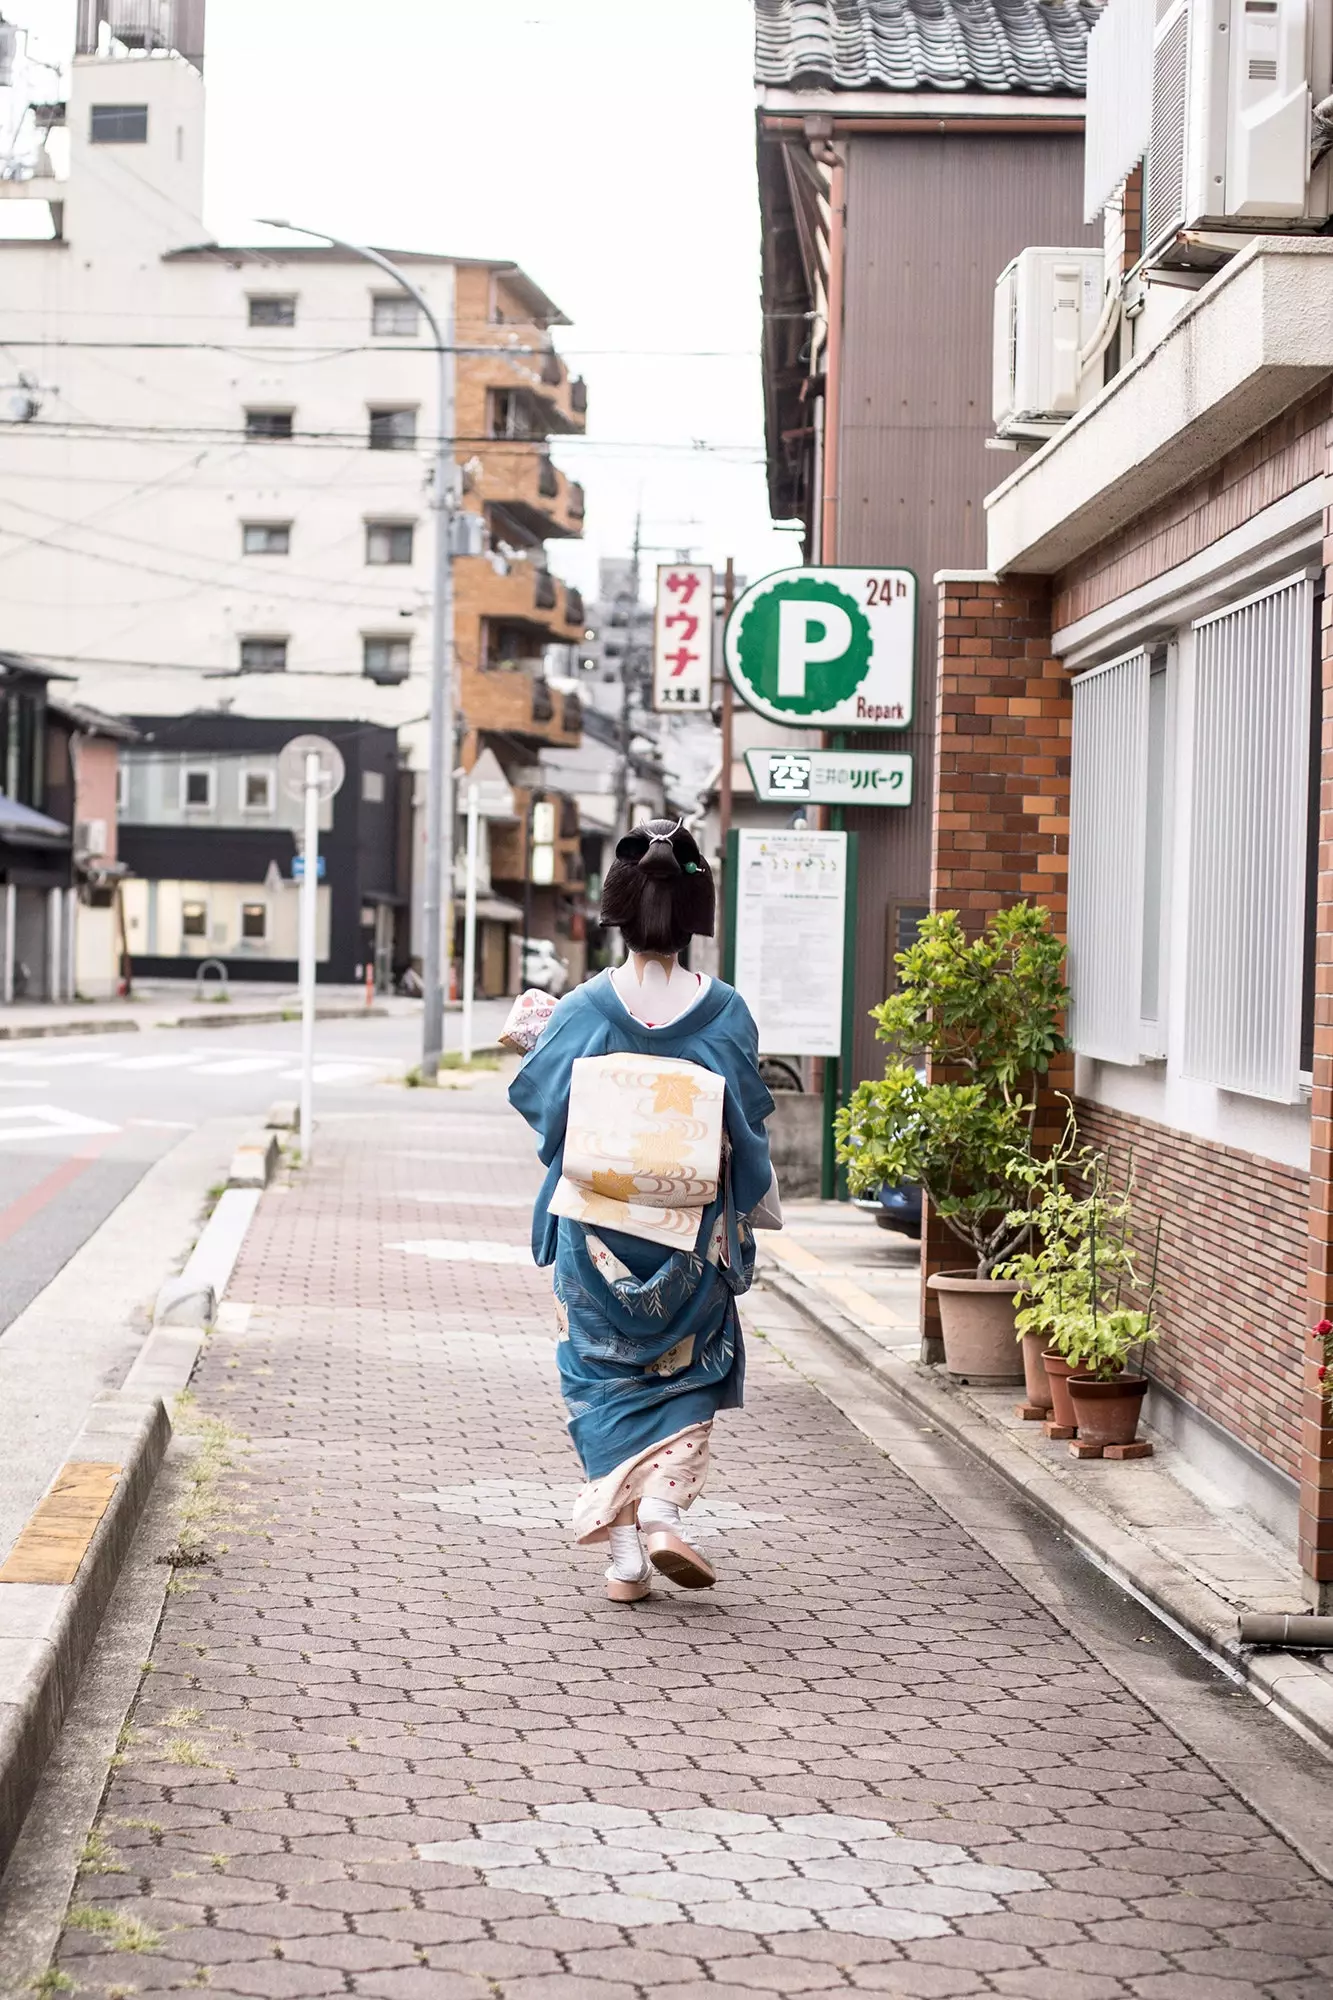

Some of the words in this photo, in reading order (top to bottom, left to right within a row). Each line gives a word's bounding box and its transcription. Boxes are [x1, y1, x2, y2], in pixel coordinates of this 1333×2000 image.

[866, 578, 906, 606] 24h
[665, 573, 700, 676] サウナ
[777, 599, 853, 697] P
[856, 696, 904, 721] Repark
[768, 755, 811, 797] 空
